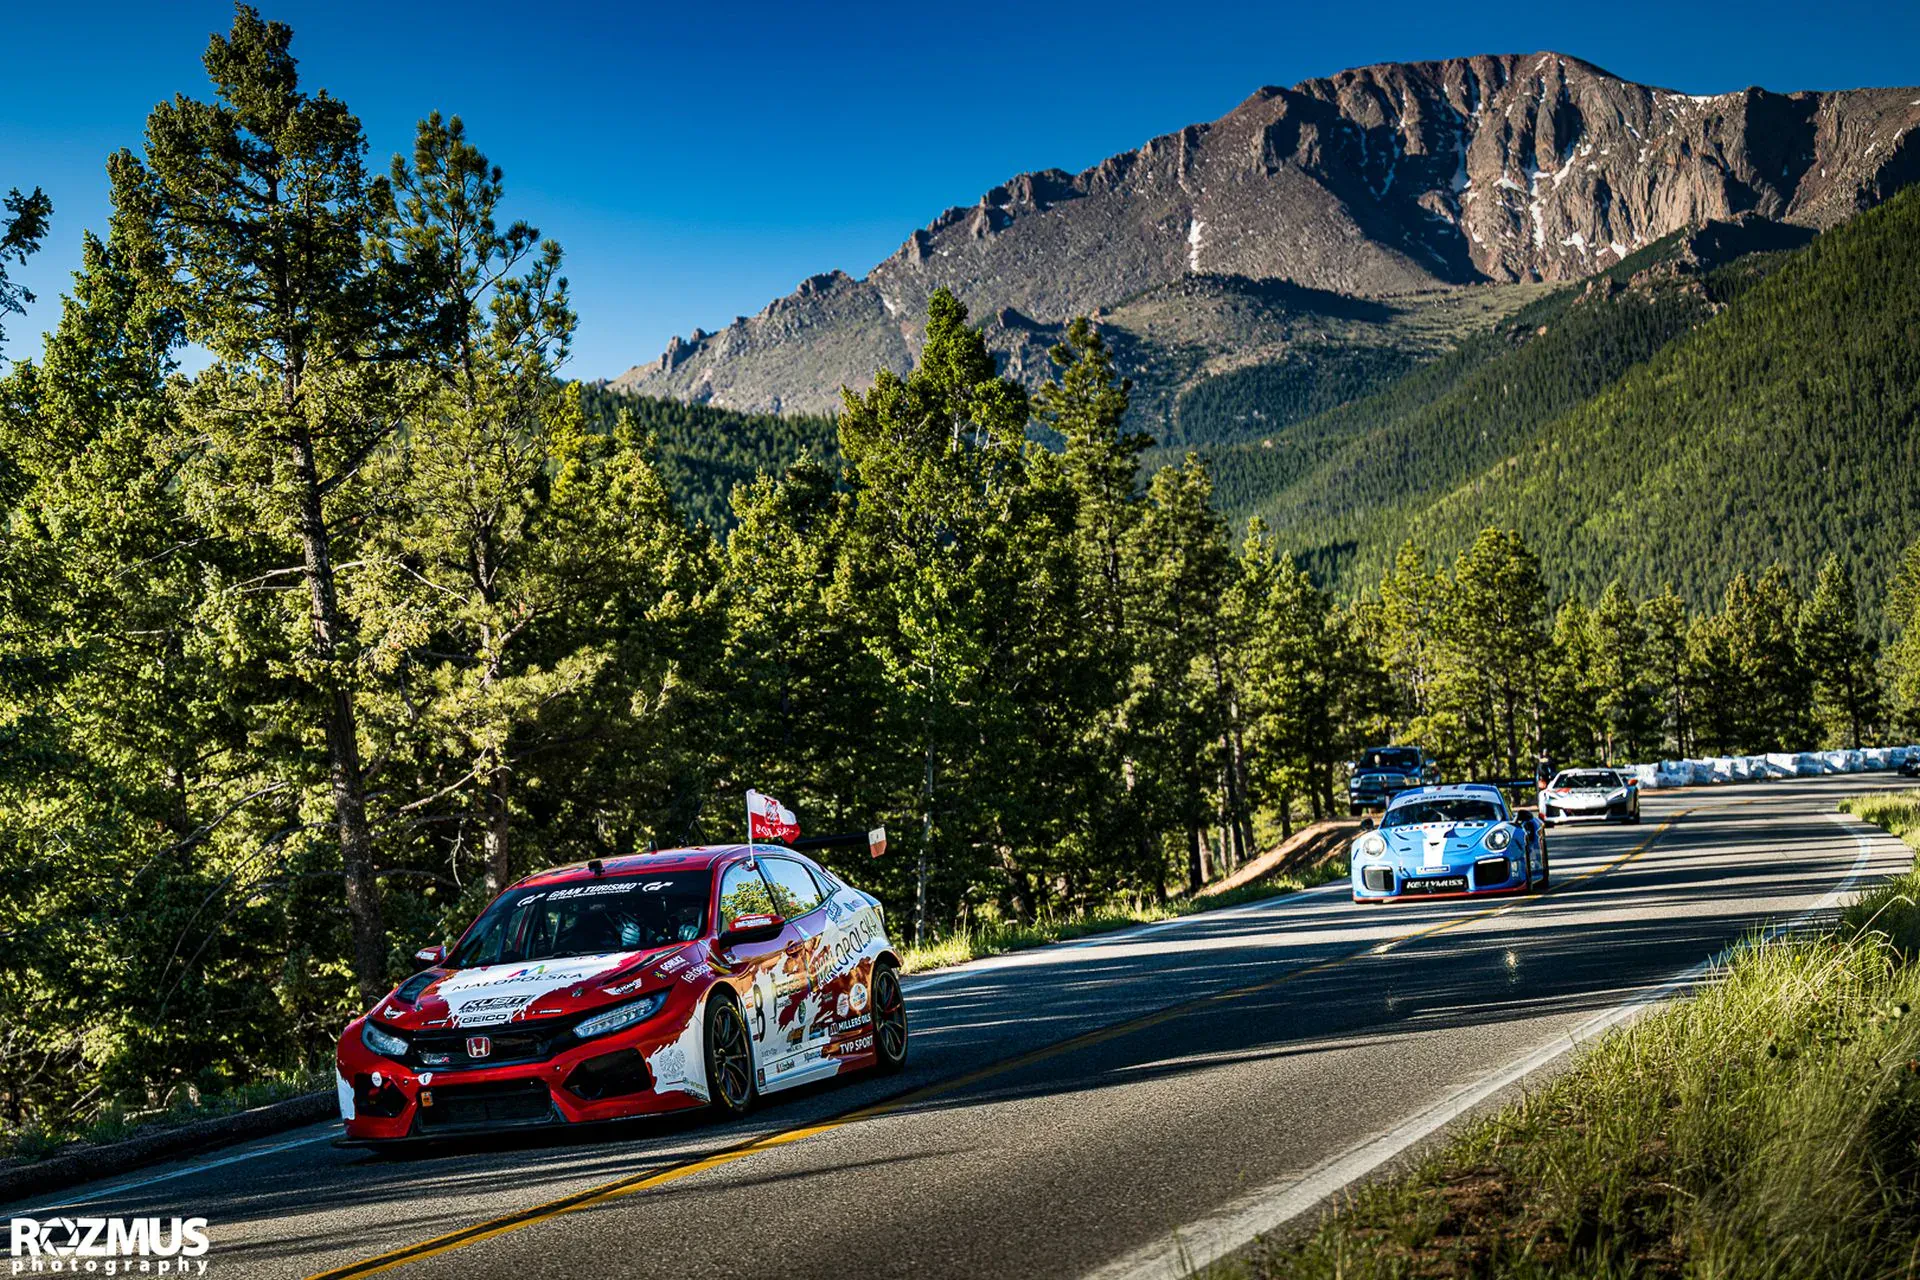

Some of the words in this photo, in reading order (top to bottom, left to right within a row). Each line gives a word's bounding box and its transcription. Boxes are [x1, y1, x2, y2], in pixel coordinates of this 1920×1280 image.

[548, 888, 583, 898] GRAN
[583, 883, 637, 894] TURISMO
[461, 1014, 507, 1024] GEICO
[838, 1016, 861, 1031] MILLERS
[840, 1041, 855, 1054] TVP
[855, 1035, 873, 1050] SPORT
